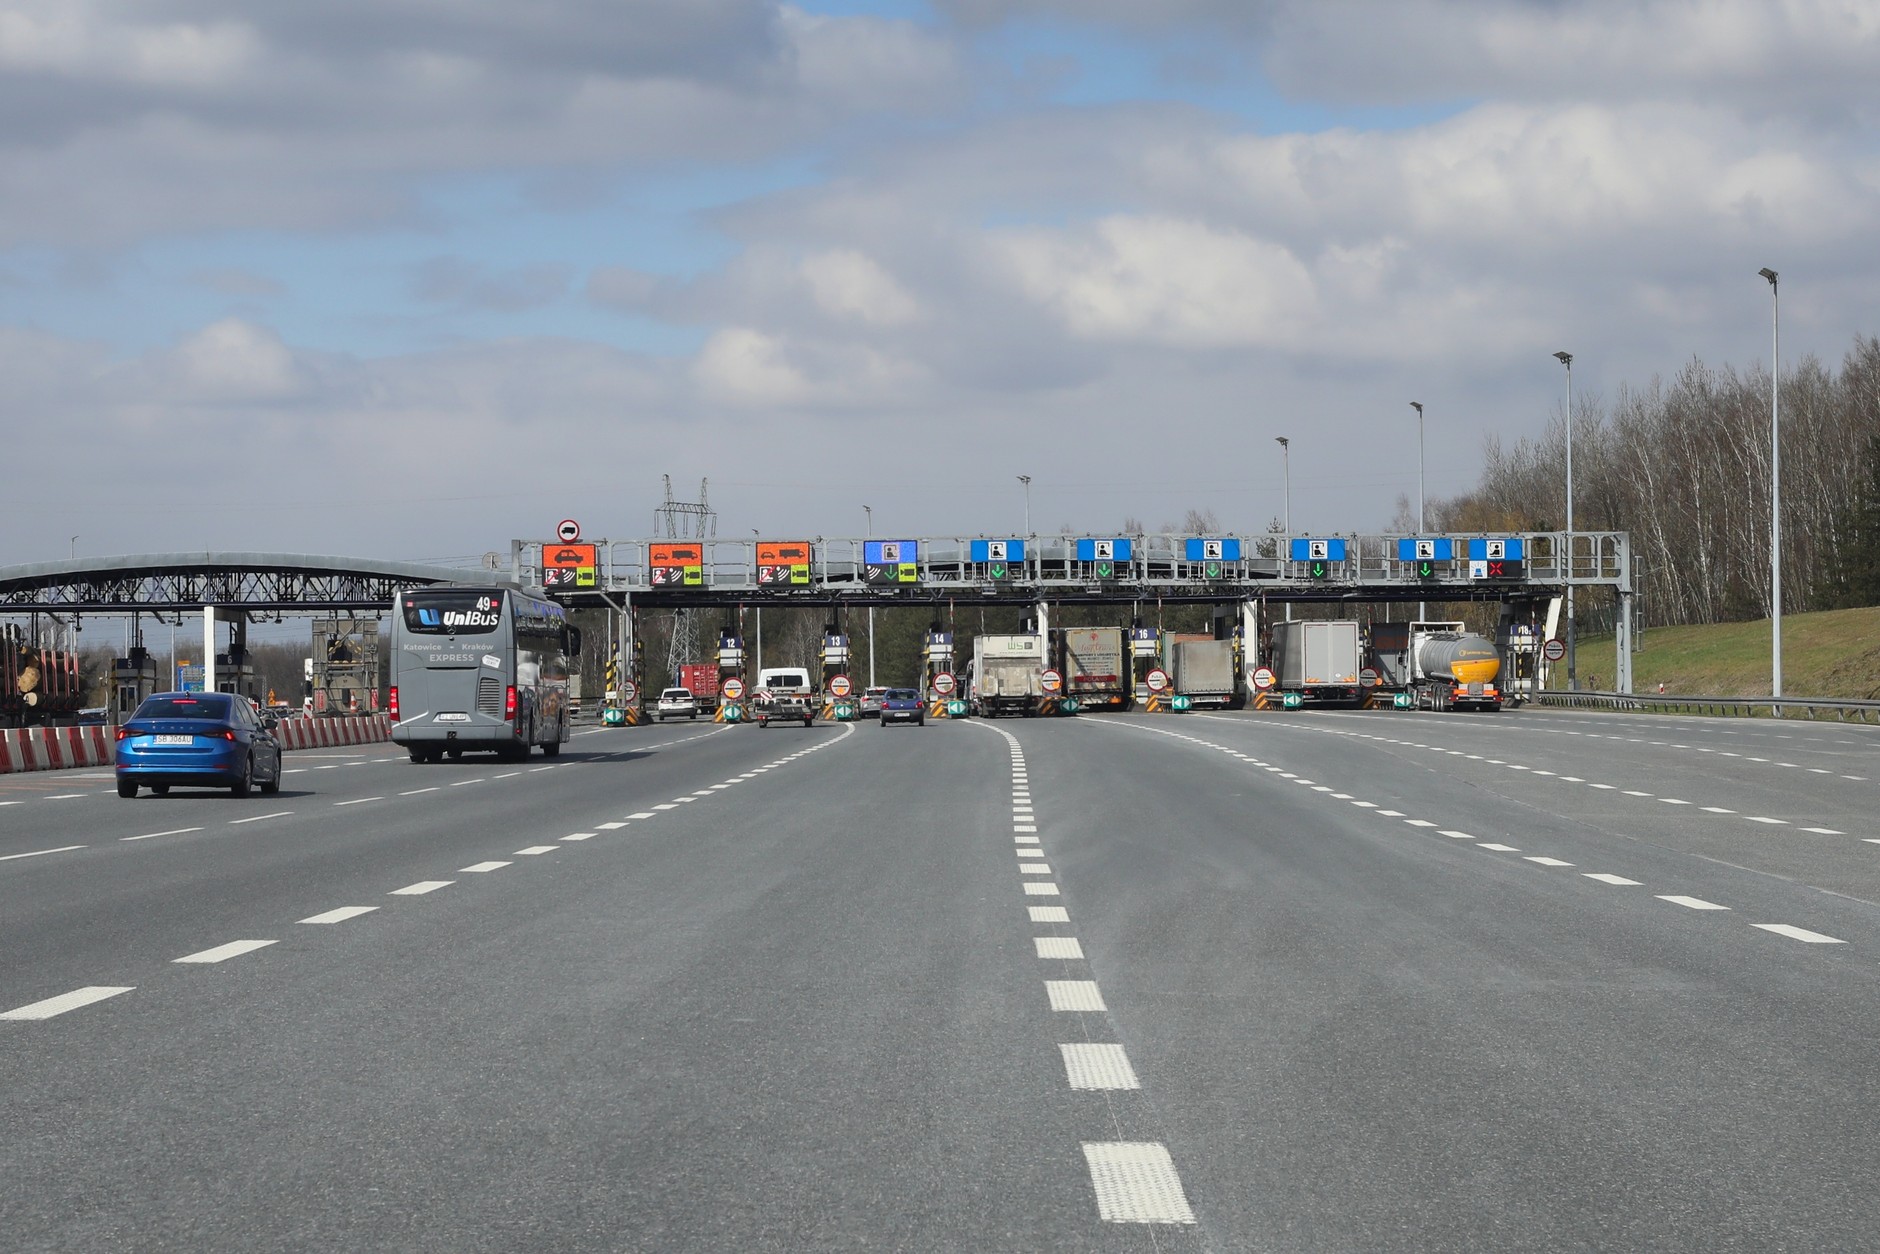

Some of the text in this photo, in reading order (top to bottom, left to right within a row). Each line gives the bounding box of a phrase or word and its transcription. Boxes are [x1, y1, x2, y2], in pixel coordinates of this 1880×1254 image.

[476, 596, 490, 611] 49
[443, 611, 499, 626] UniBus
[934, 633, 944, 643] 14
[1138, 629, 1148, 639] 16
[726, 638, 735, 648] 12
[831, 636, 841, 646] 13
[403, 643, 442, 651] Katowice
[227, 655, 233, 664] 6
[429, 654, 474, 662] EXPRESS
[127, 659, 132, 668] 5
[158, 735, 167, 743] SB
